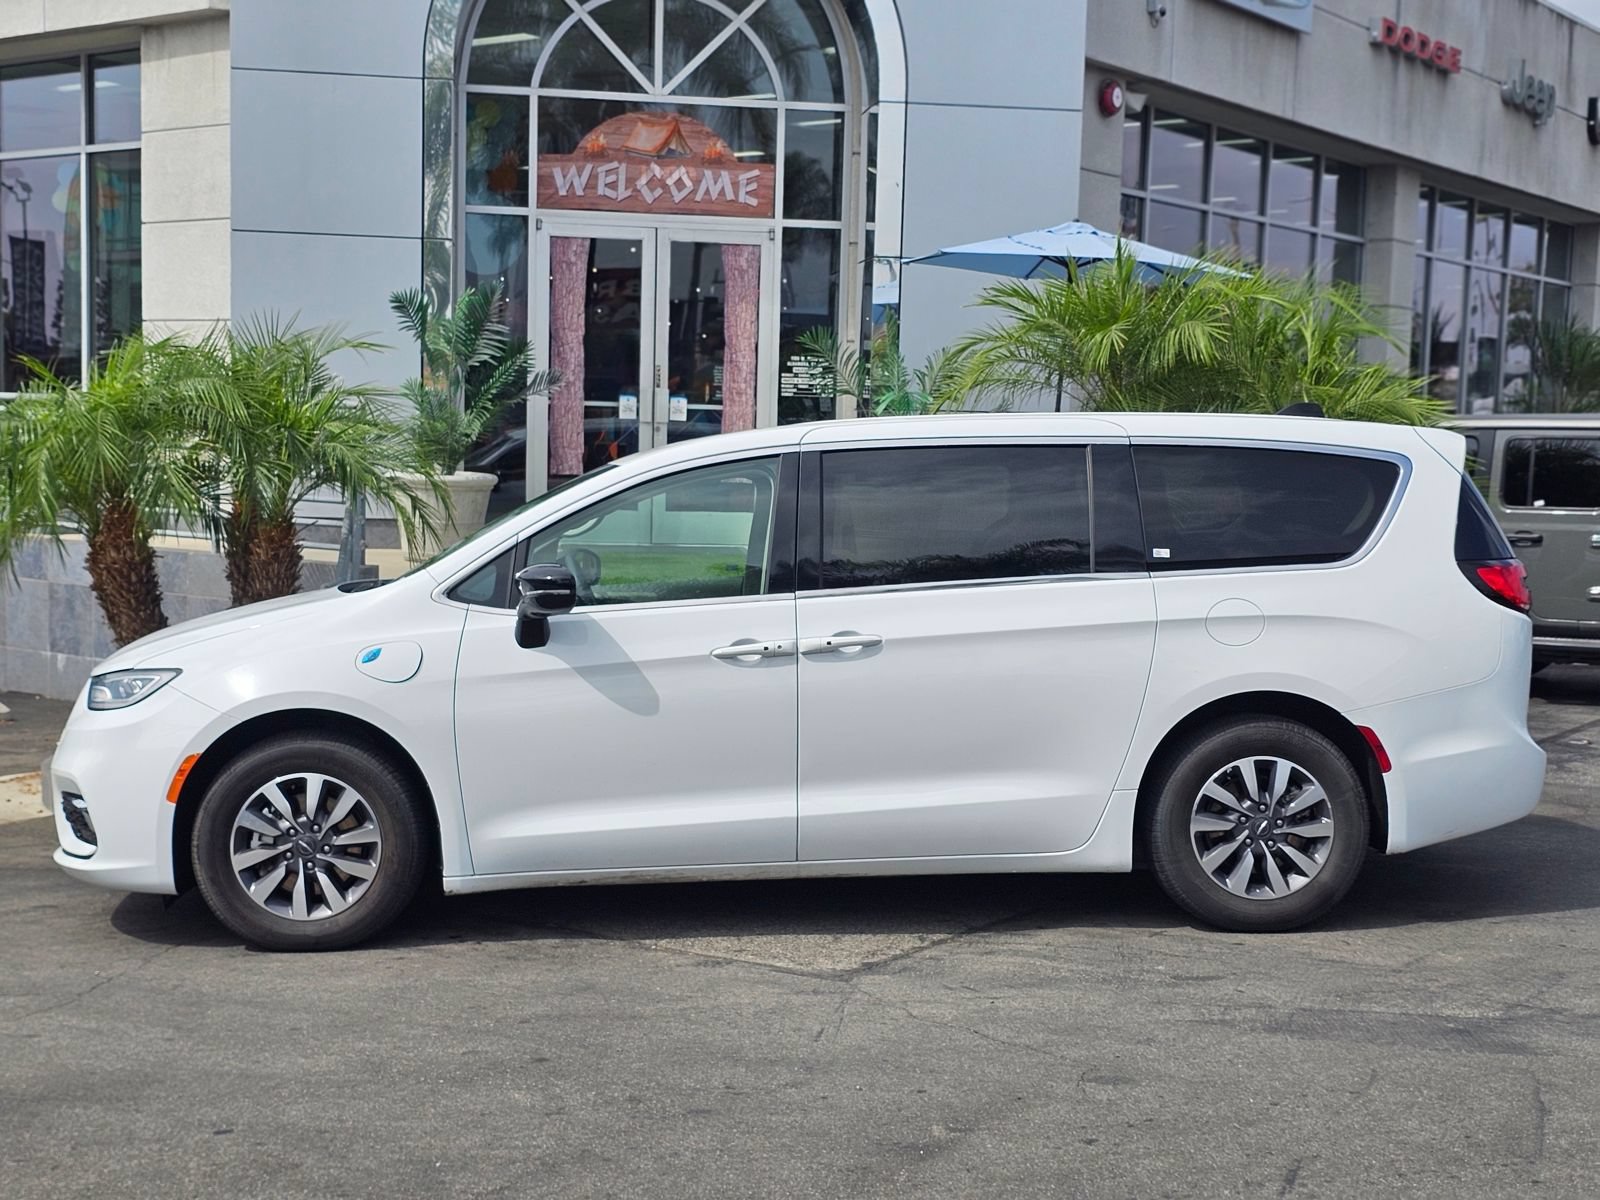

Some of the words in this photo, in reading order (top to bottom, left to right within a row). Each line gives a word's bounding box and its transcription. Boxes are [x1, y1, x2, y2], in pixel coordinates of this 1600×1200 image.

[1380, 16, 1462, 74] DODGE
[1510, 58, 1556, 126] Jeep
[552, 160, 761, 207] WELCOME
